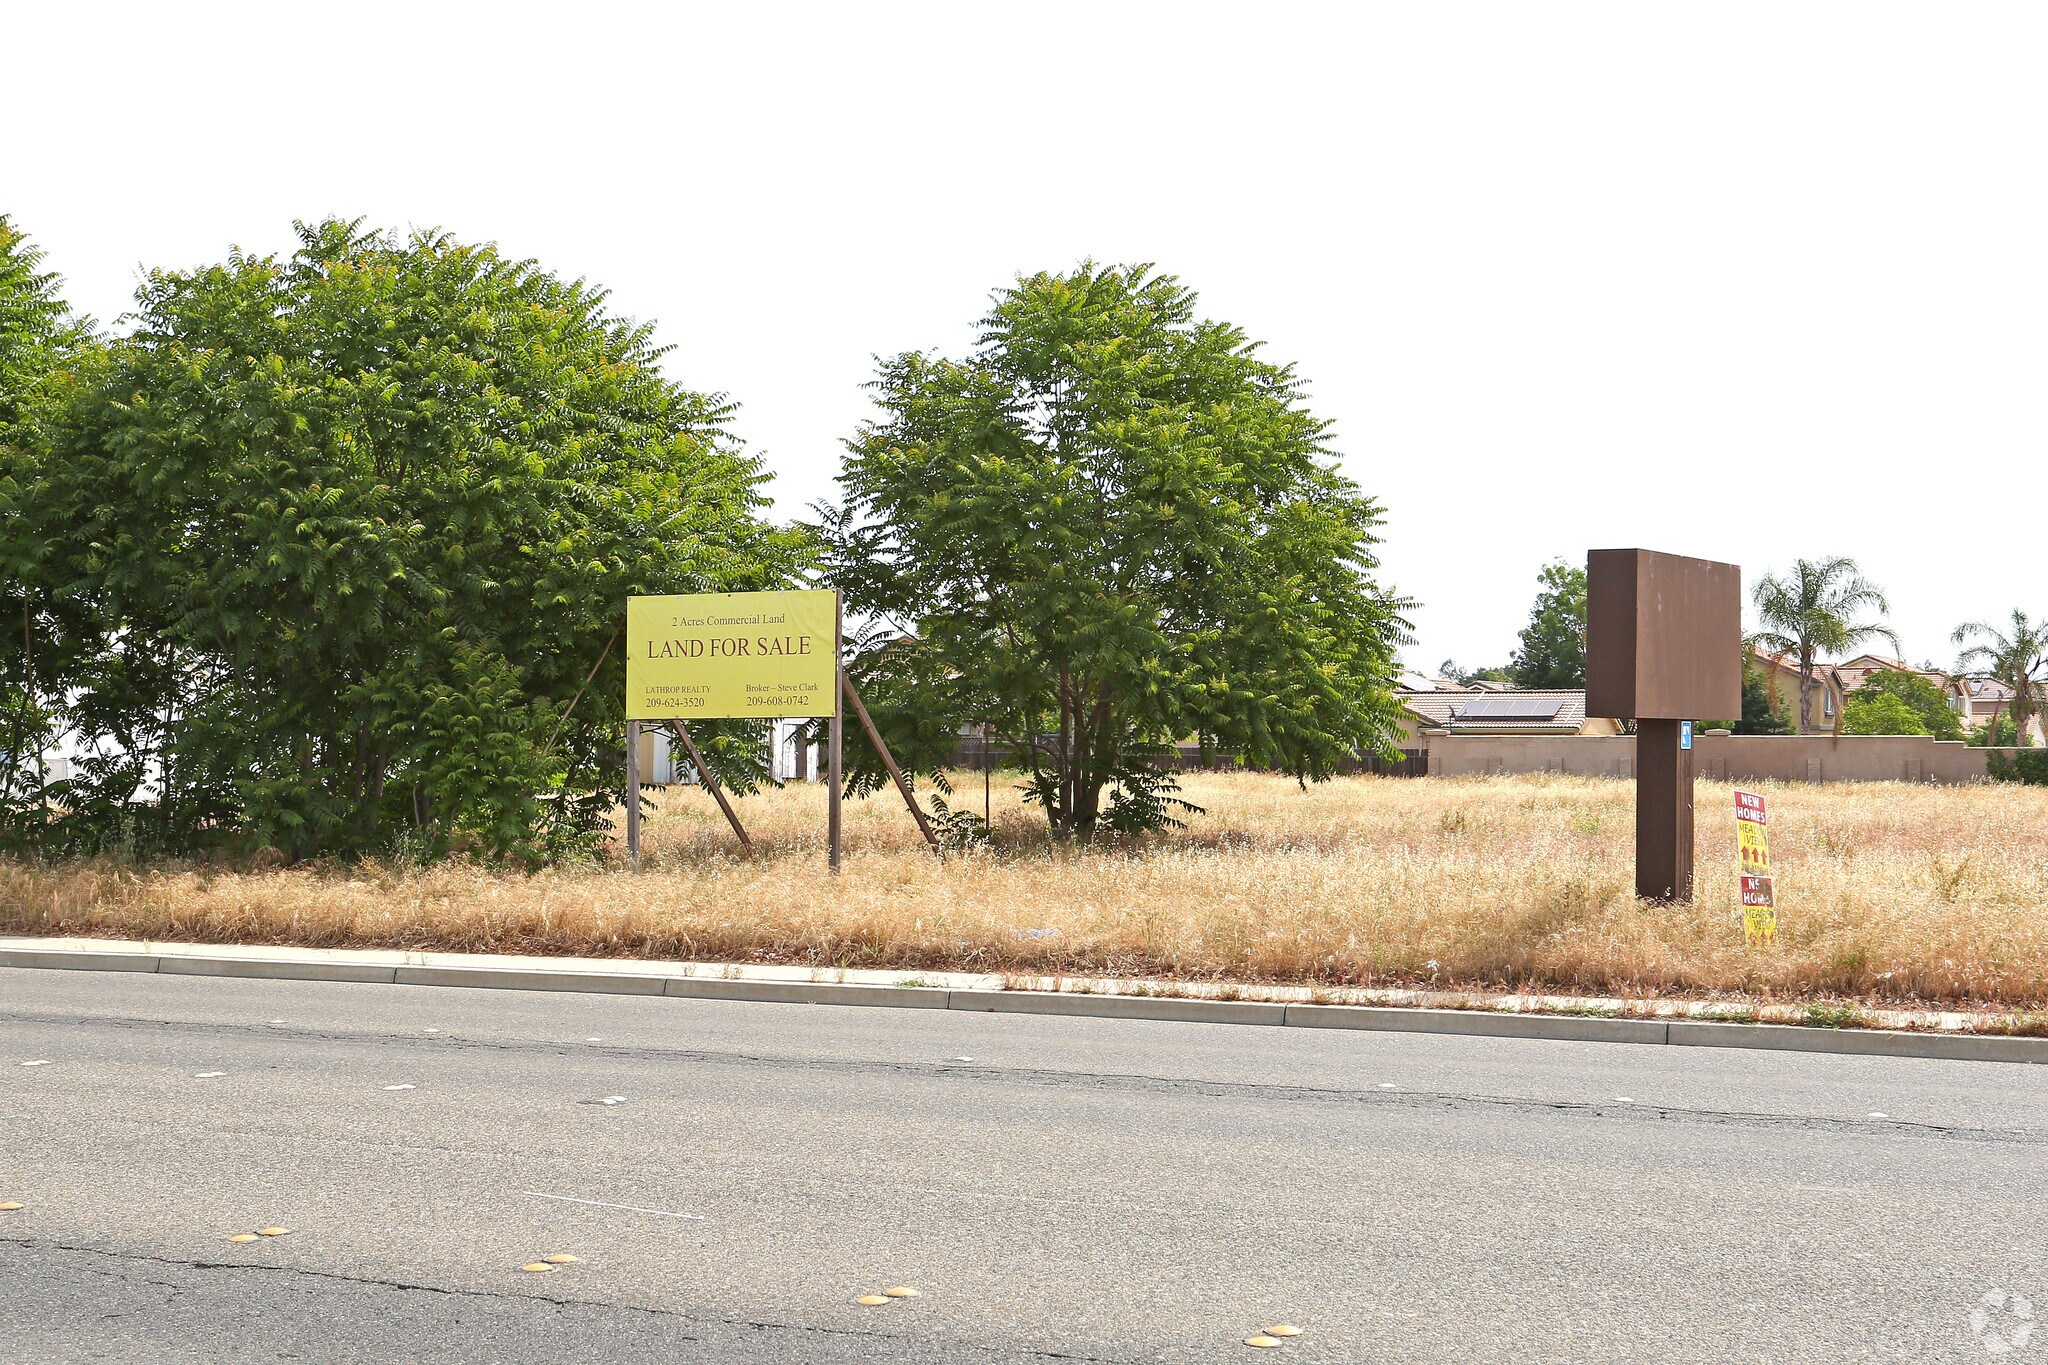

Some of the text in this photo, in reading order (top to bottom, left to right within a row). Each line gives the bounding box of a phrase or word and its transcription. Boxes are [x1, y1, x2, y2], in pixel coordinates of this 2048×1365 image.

[672, 613, 785, 627] 2 Acres Commercial Land
[647, 636, 811, 659] LAND FOR SALE
[645, 685, 711, 694] LATHROP REALTY
[746, 684, 770, 693] Broker
[777, 684, 798, 692] Steve
[799, 682, 819, 691] Clark
[646, 697, 705, 709] 209-624-3520
[746, 696, 809, 707] 209-608-0742
[1740, 793, 1760, 809] NEW
[1737, 806, 1766, 823] HOMES
